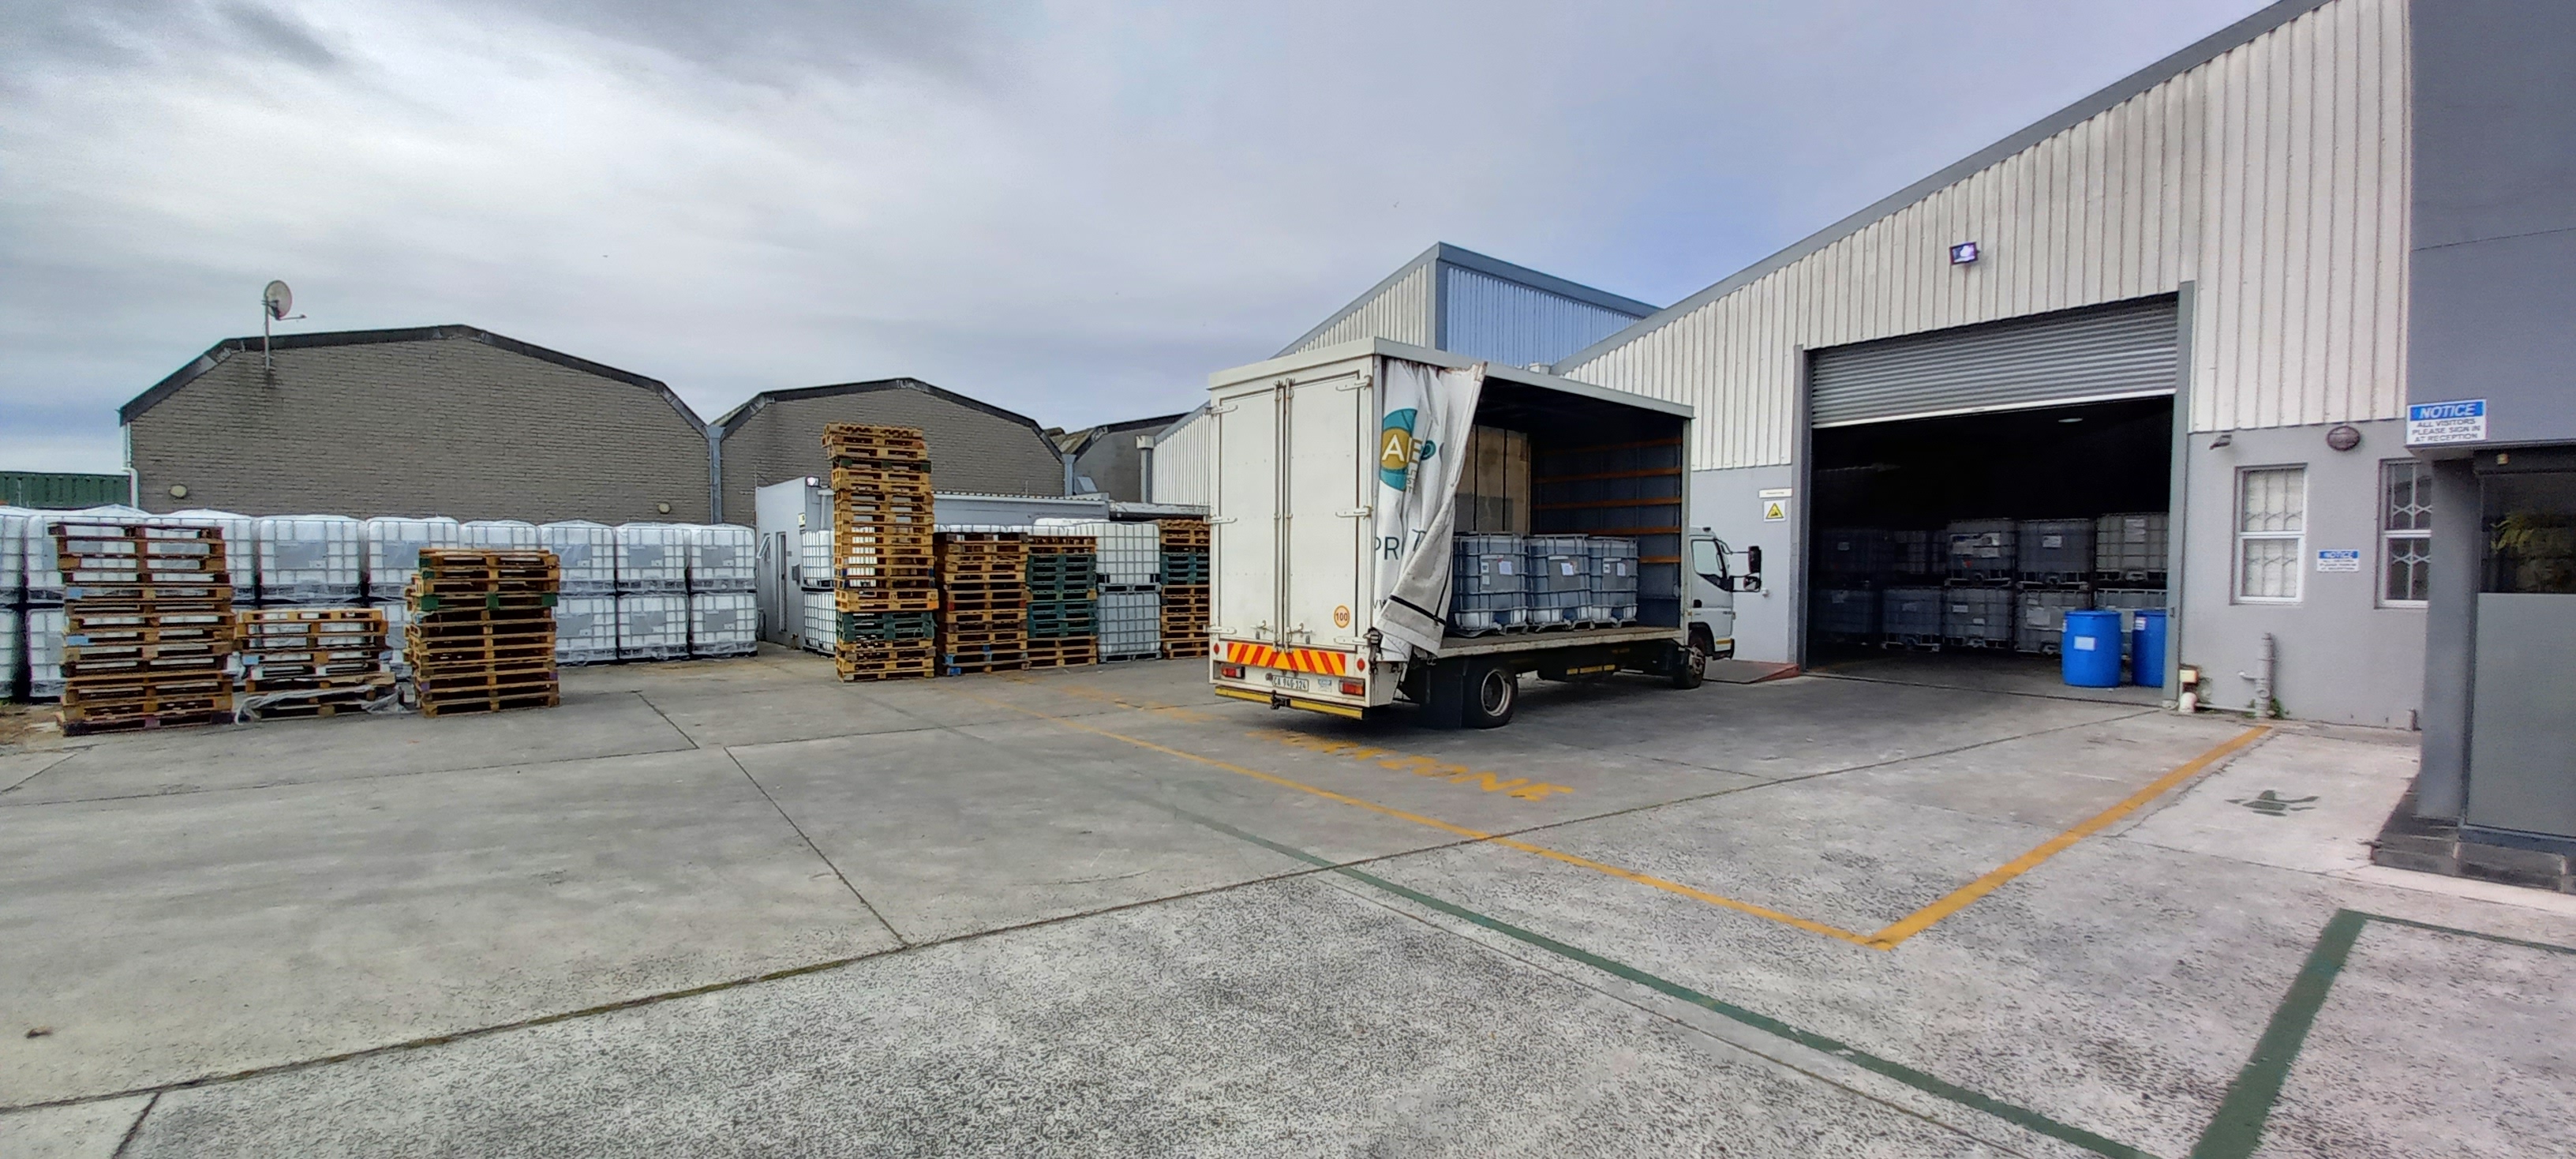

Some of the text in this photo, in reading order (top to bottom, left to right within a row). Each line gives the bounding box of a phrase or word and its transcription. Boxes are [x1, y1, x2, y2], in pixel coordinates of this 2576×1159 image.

[2419, 403, 2477, 419] NOTICE
[2427, 433, 2478, 441] RECEPTION
[1335, 612, 1348, 621] 100
